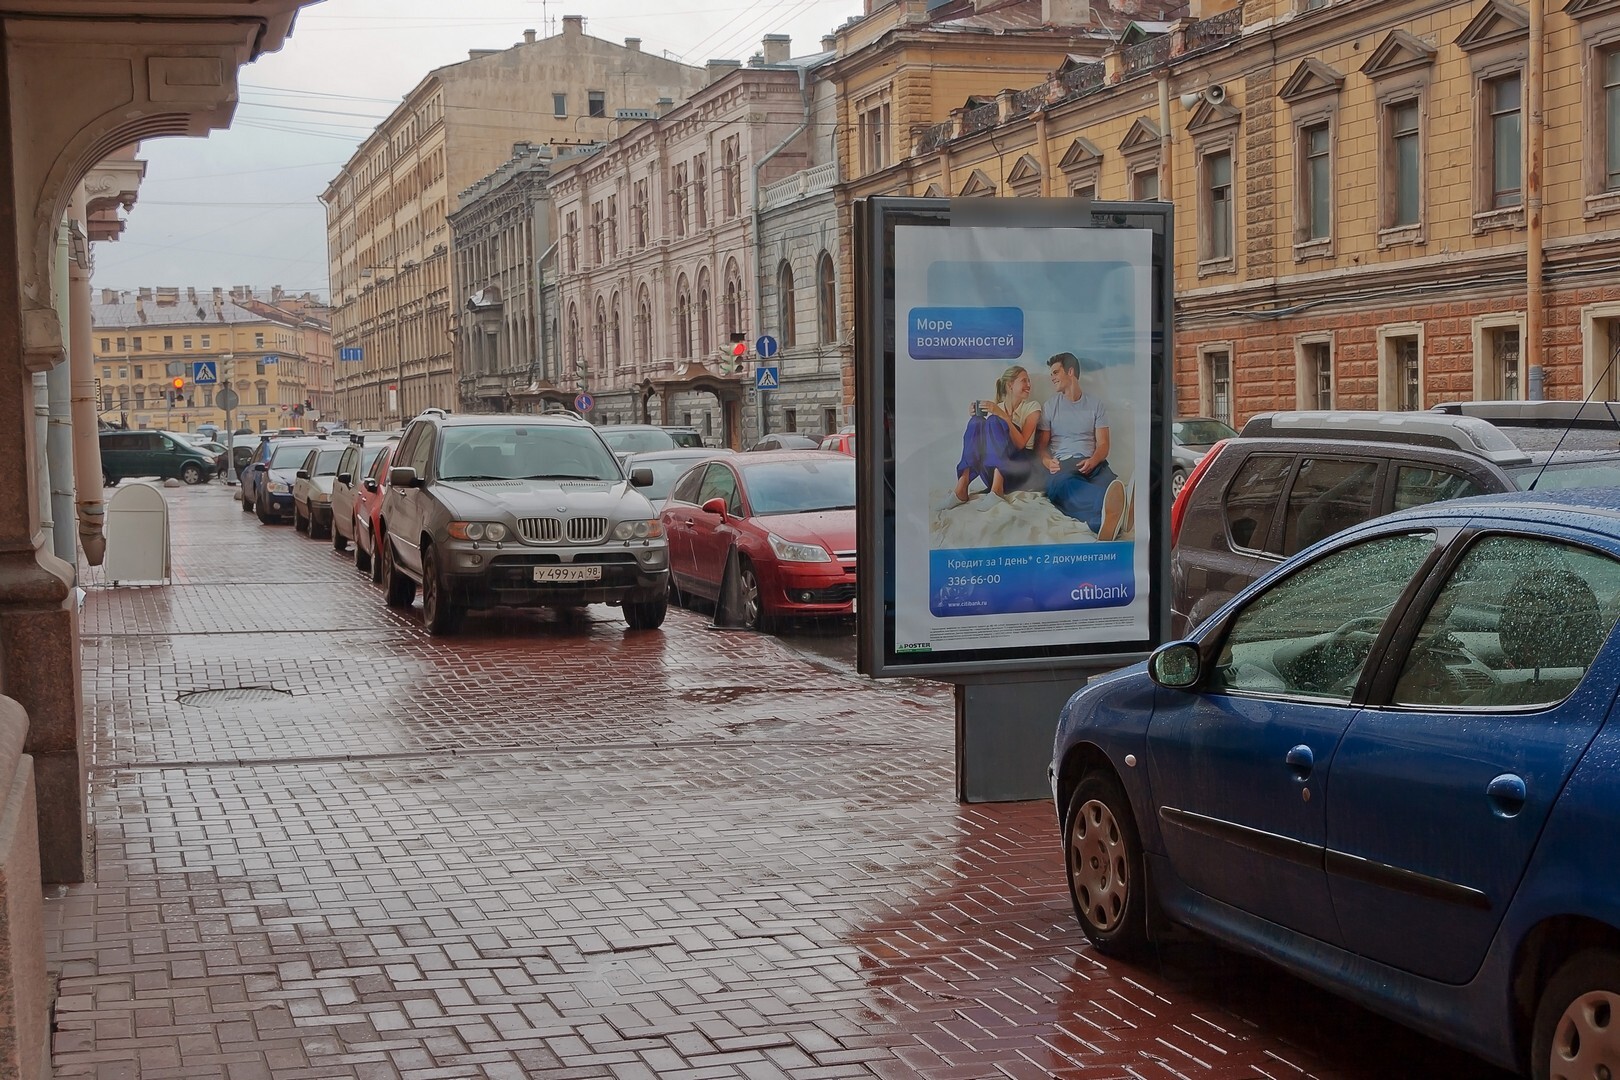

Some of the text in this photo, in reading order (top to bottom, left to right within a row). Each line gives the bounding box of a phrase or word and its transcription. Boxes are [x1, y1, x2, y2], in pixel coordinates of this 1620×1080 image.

[917, 318, 953, 332] Море
[917, 334, 1014, 347] возможностей
[947, 559, 983, 569] Кредит
[1044, 554, 1050, 563] 2
[1052, 552, 1117, 564] документами
[587, 567, 598, 576] 98
[947, 574, 1001, 586] 336-66-00
[1070, 583, 1128, 601] citibank
[947, 600, 988, 608] www.citibank.ru
